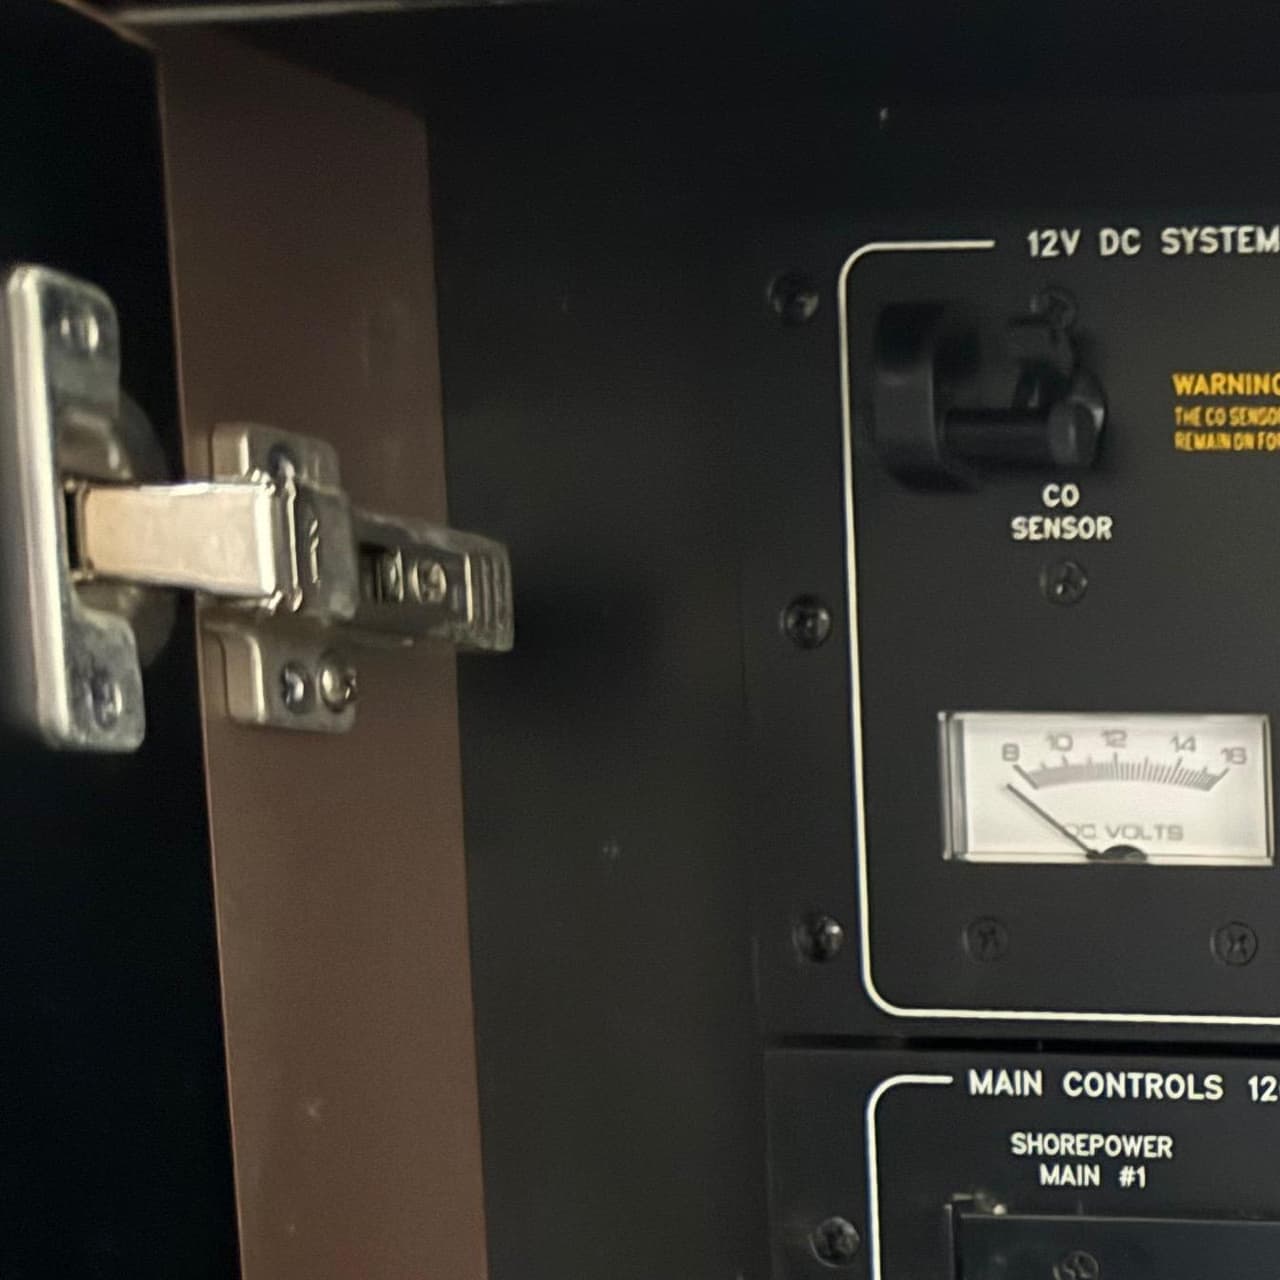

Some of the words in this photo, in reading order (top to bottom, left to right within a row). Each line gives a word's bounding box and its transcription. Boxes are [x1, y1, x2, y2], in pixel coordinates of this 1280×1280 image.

[1028, 230, 1080, 256] 12V
[1100, 228, 1140, 255] DC
[1162, 226, 1280, 254] SYSTEM
[1175, 406, 1201, 426] THE
[1205, 407, 1226, 426] CO
[1175, 432, 1231, 450] REMAIN
[1233, 433, 1255, 450] ON
[1043, 484, 1079, 507] CO
[1012, 516, 1112, 540] SENSOR
[1002, 743, 1020, 762] 8
[1046, 731, 1073, 751] 10
[1101, 729, 1128, 747] 12
[1170, 734, 1196, 752] 14
[1104, 823, 1184, 841] VOLTS
[969, 1069, 1042, 1096] MAIN
[1063, 1071, 1223, 1100] CONTROLS
[1011, 1132, 1172, 1158] SHOREPOWER
[1040, 1164, 1100, 1186] MAIN
[1119, 1166, 1145, 1187] #1
